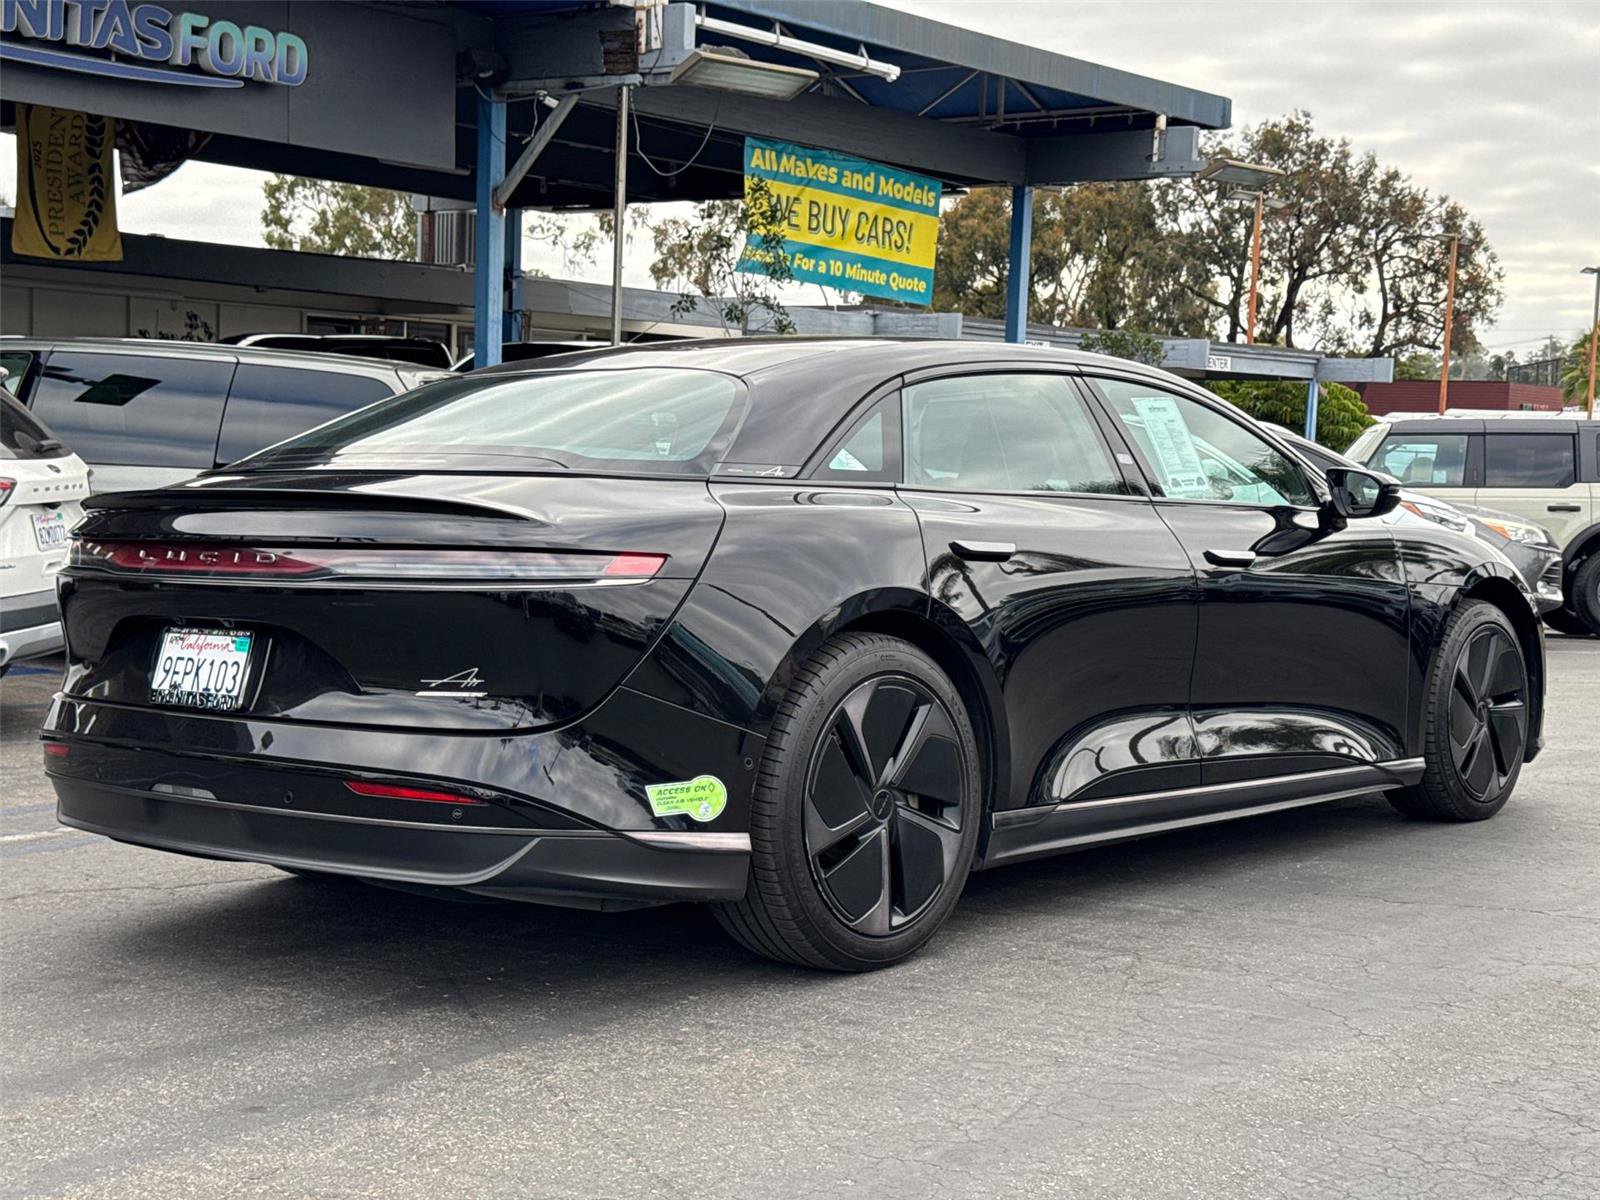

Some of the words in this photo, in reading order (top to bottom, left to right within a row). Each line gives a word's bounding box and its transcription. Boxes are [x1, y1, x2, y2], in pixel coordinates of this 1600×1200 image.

[48, 107, 66, 236] PRESIDEN
[66, 114, 86, 205] AWARD
[751, 148, 777, 171] All
[841, 170, 875, 194] and
[878, 176, 936, 208] Models
[807, 200, 850, 241] BUY
[854, 211, 914, 254] CARS!
[793, 253, 814, 272] For
[818, 260, 827, 273] a
[829, 259, 843, 277] 10
[845, 263, 887, 286] Minute
[889, 271, 927, 294] Quote
[1208, 357, 1229, 369] ENTER
[180, 634, 235, 656] California
[158, 656, 240, 694] 9EPK103
[657, 786, 692, 797] ACCESS
[694, 785, 707, 793] OK
